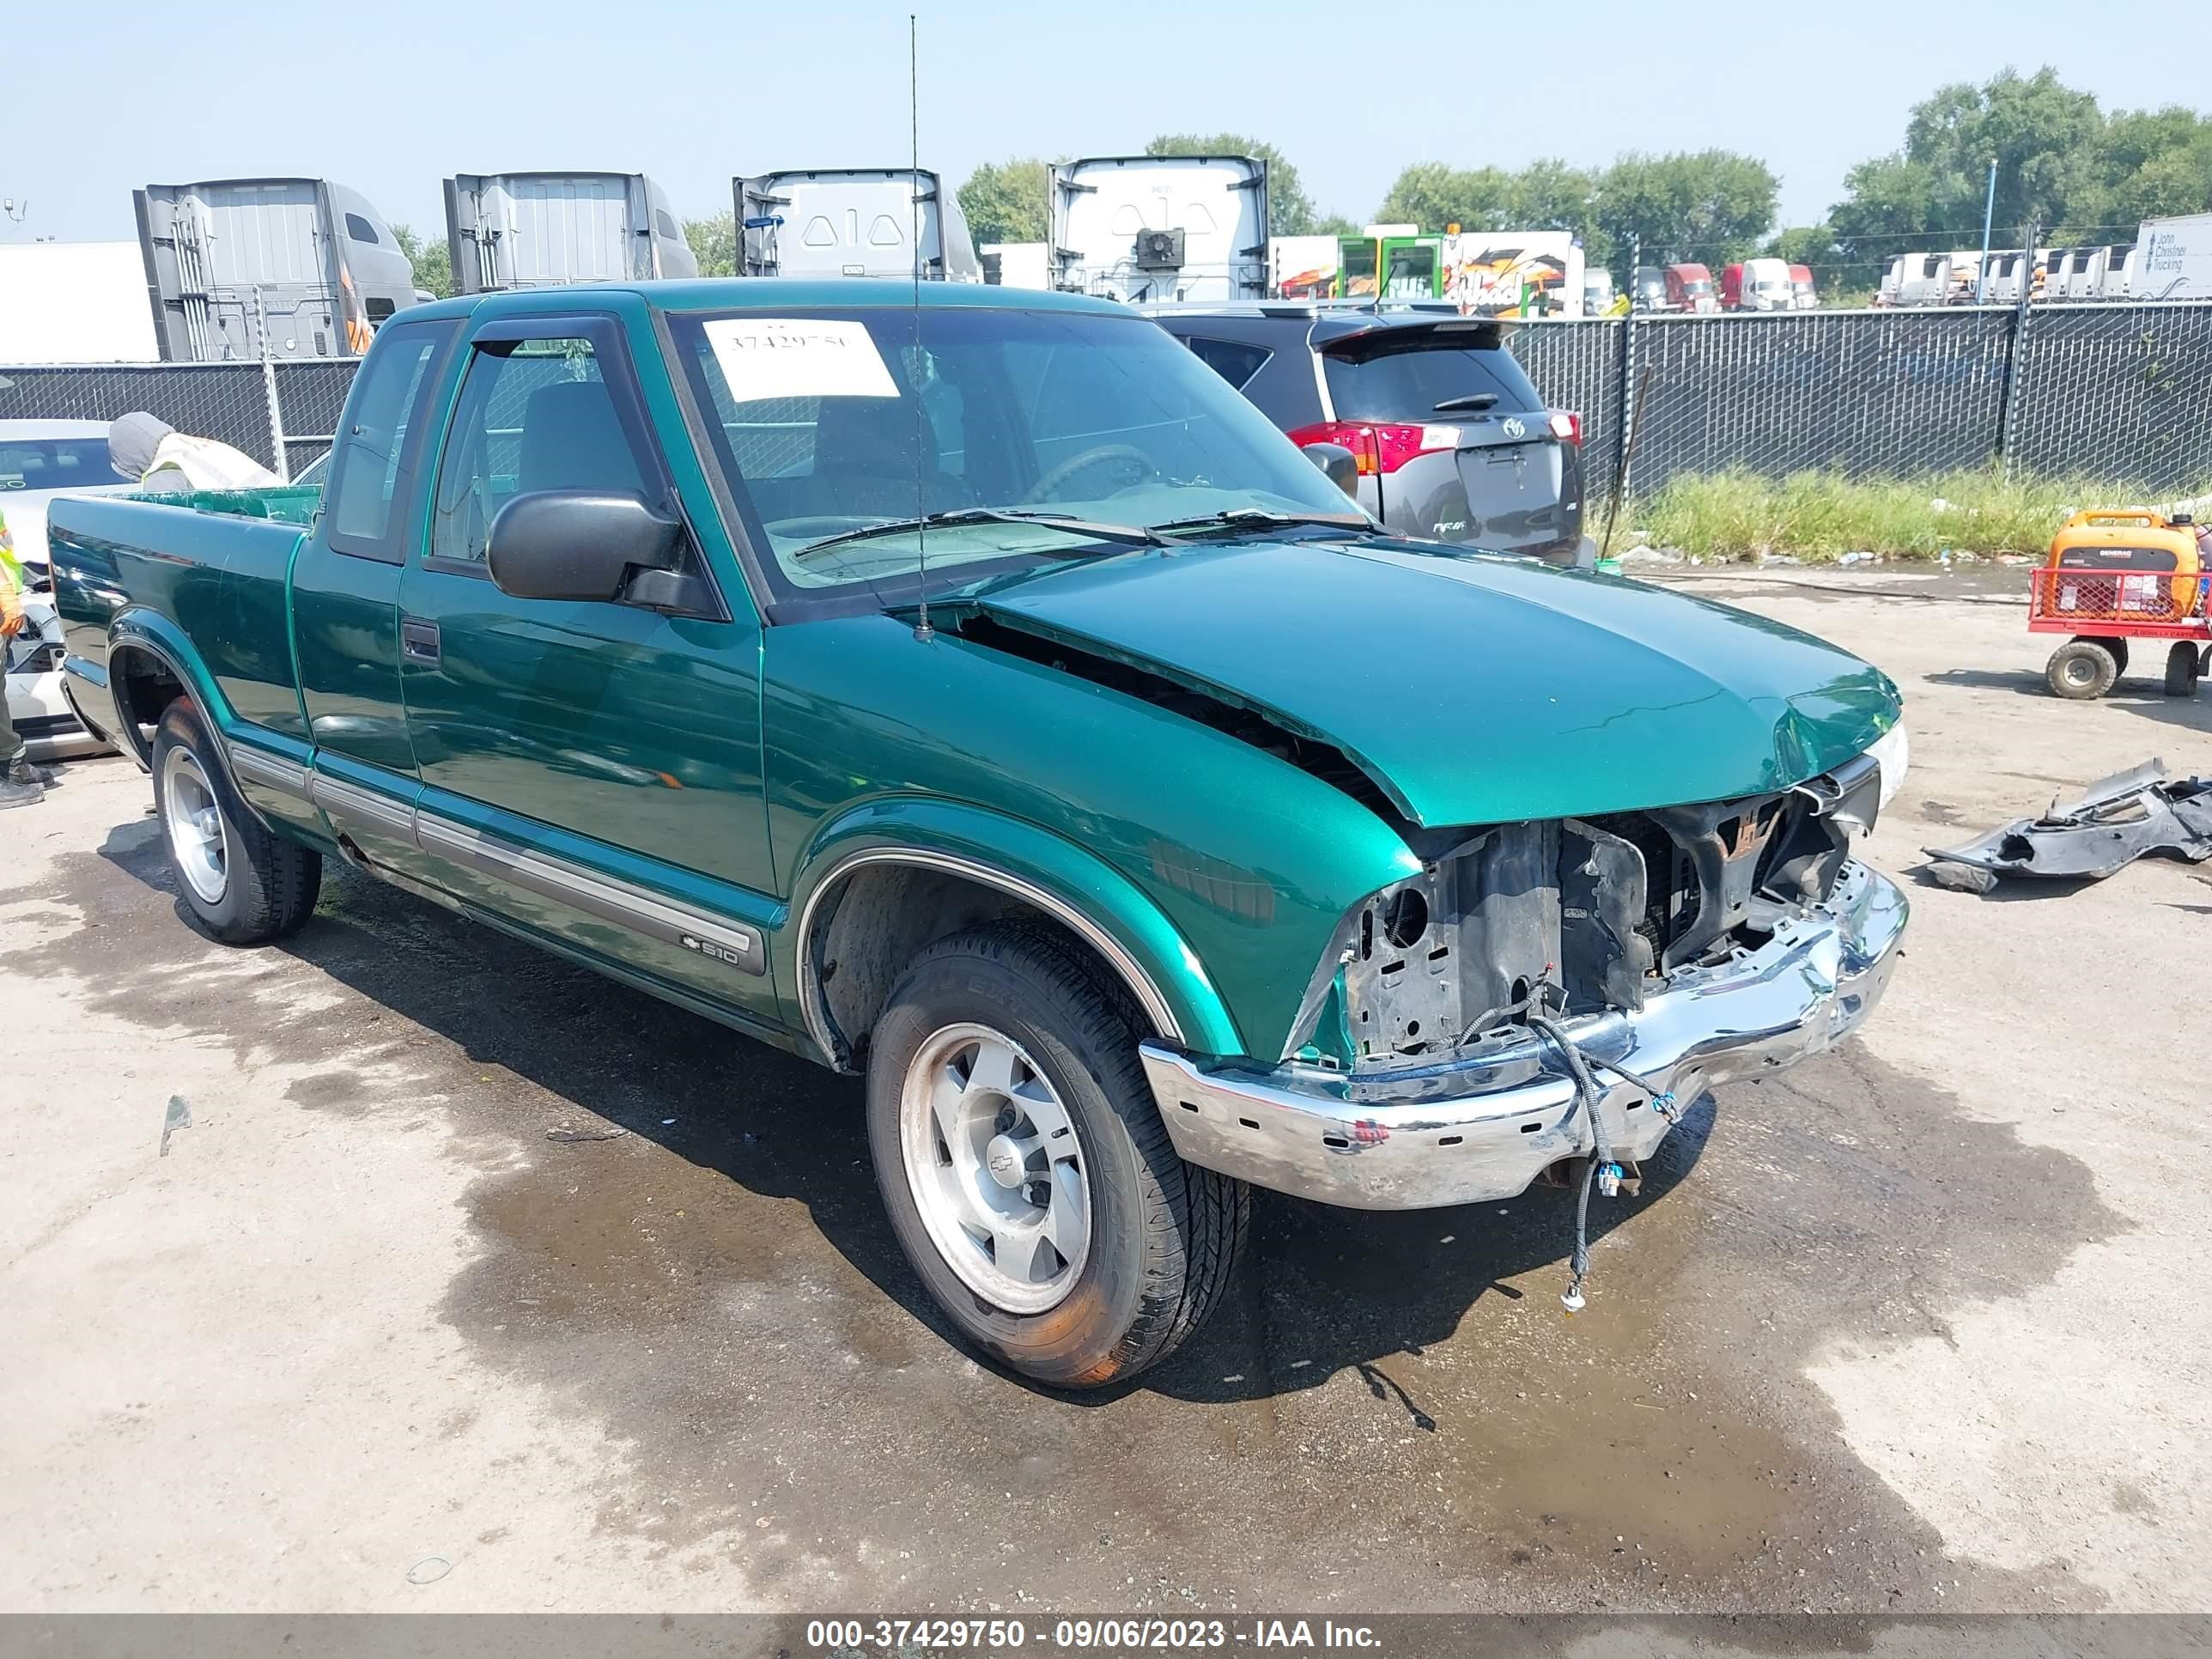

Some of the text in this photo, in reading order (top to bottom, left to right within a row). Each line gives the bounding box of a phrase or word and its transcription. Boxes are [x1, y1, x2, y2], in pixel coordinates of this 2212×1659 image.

[2157, 233, 2174, 245] John
[2155, 245, 2186, 257] Christner
[2154, 258, 2182, 273] Trucking
